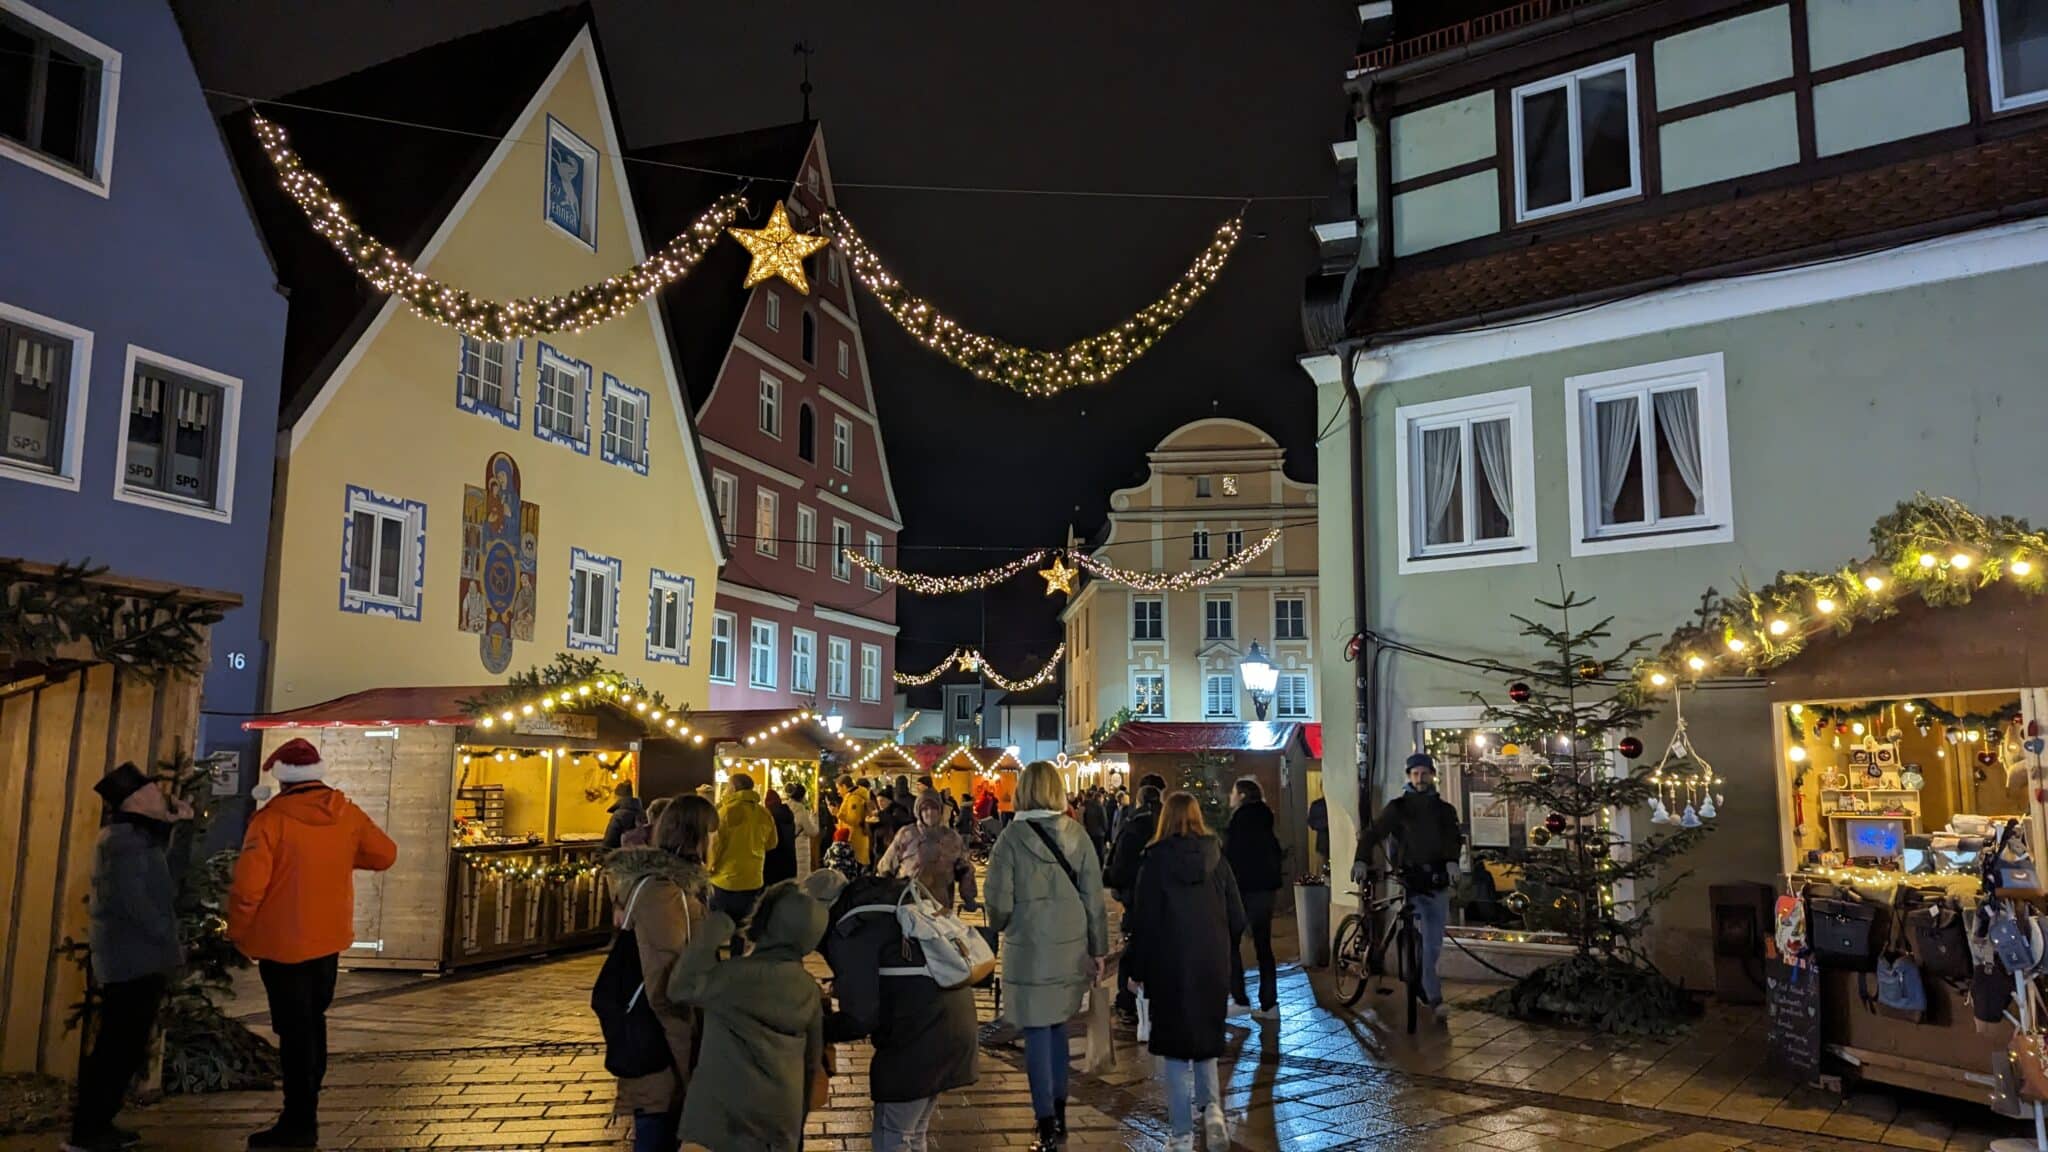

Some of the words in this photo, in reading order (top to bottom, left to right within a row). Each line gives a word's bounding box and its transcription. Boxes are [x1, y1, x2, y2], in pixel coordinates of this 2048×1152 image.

[12, 435, 41, 452] SPD
[128, 463, 153, 478] SPD
[175, 474, 199, 489] SPD
[227, 652, 246, 670] 16
